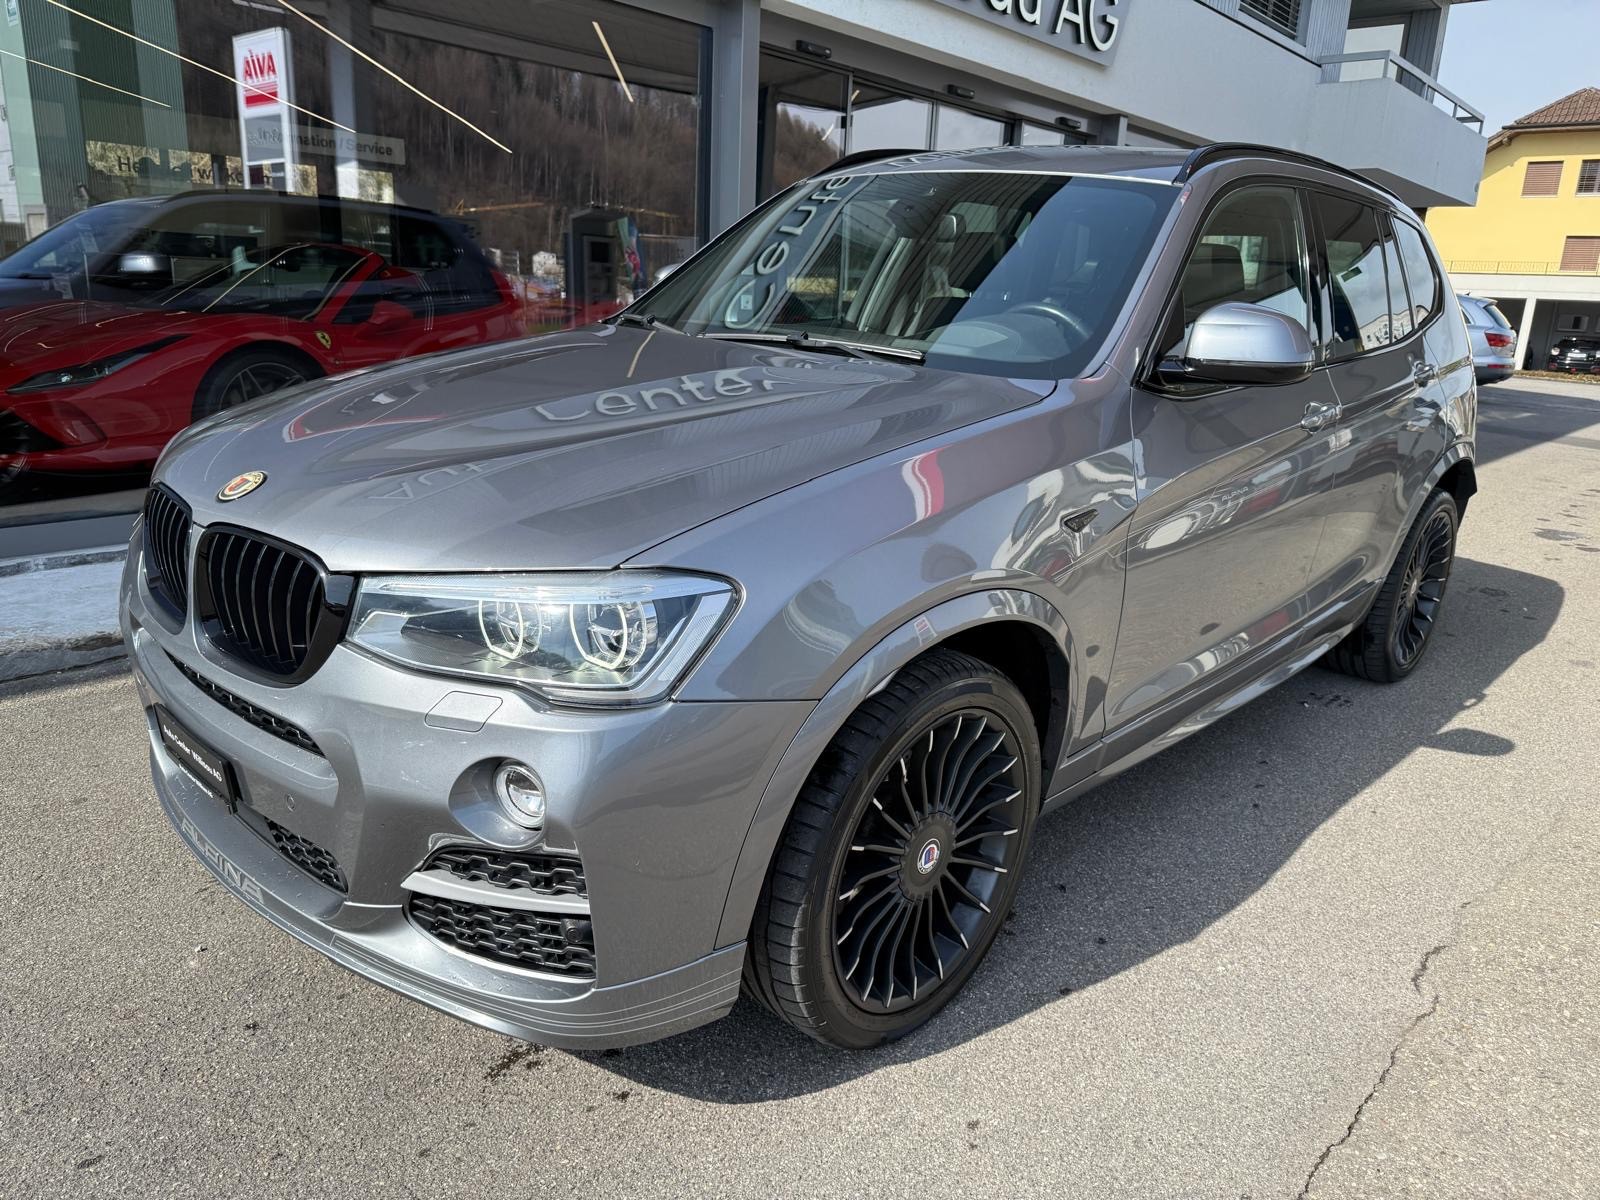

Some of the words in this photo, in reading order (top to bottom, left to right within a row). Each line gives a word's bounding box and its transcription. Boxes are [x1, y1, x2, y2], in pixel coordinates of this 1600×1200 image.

[1053, 0, 1119, 52] AG
[345, 138, 393, 157] Service
[181, 818, 264, 905] ALPINA
